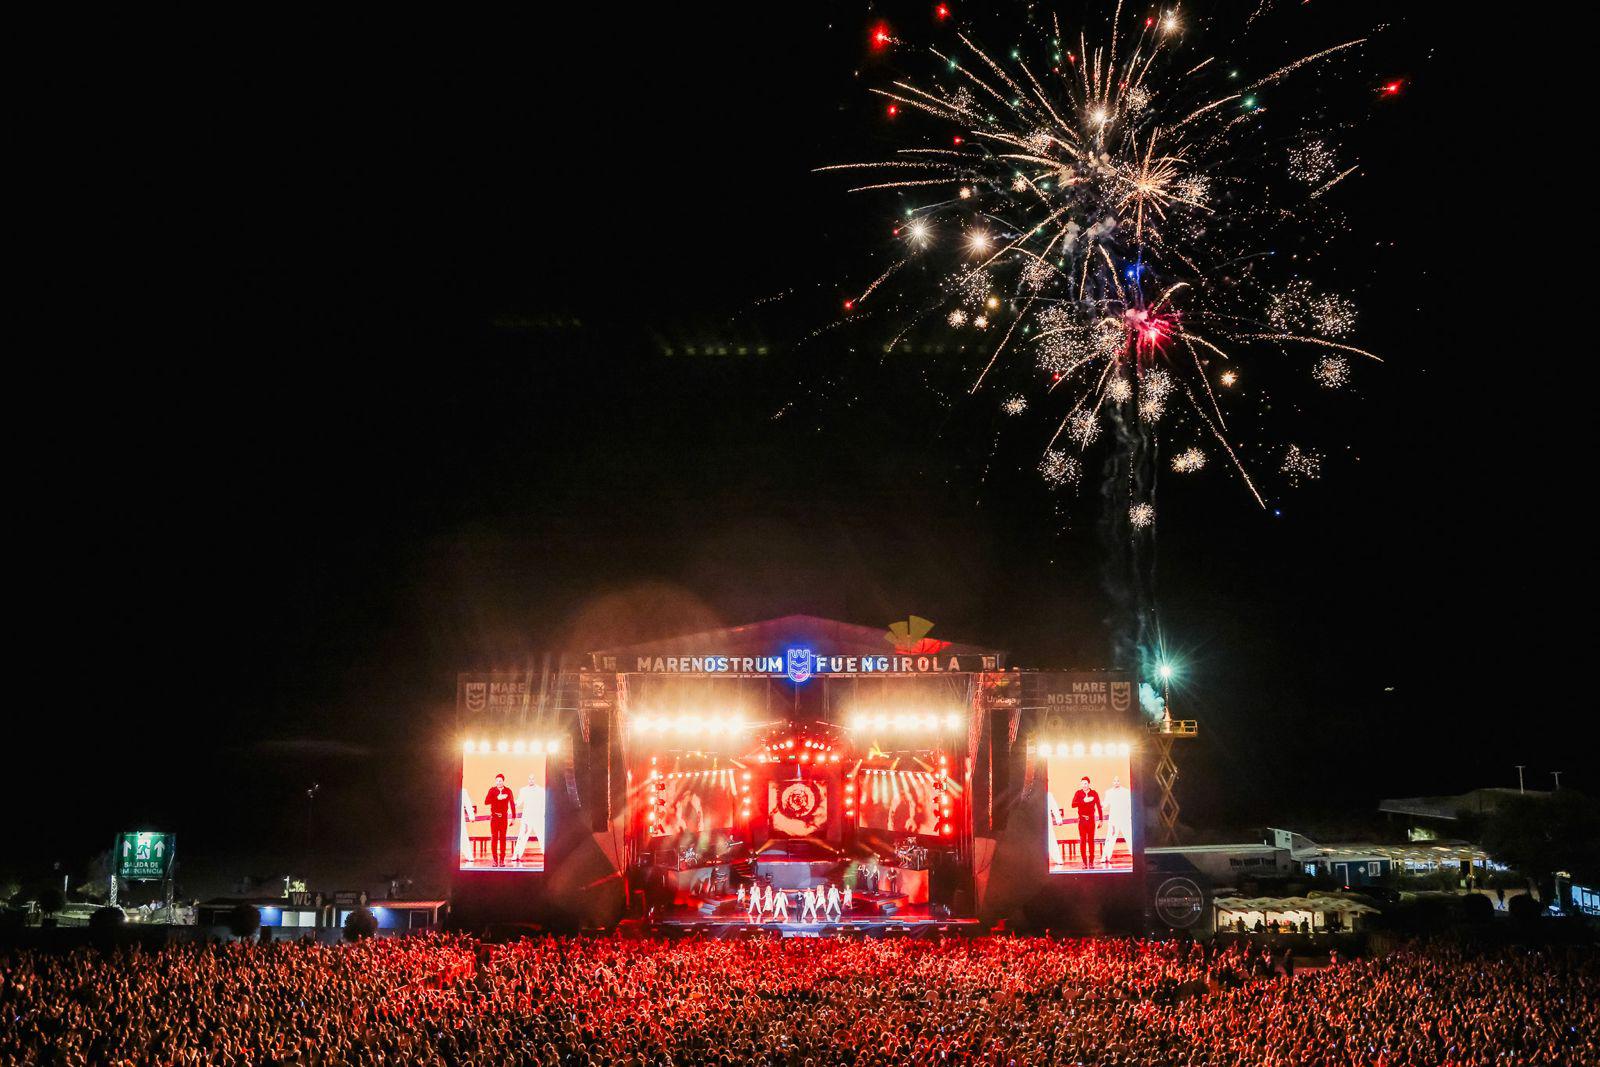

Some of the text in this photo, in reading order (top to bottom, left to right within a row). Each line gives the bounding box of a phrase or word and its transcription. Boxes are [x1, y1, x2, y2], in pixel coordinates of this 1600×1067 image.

[637, 656, 960, 672] MARENOSTRUM FUENGIROLA
[490, 682, 526, 694] MARE
[1072, 682, 1107, 693] MARE
[1047, 693, 1107, 704] NOSTRUM
[293, 892, 311, 906] WC
